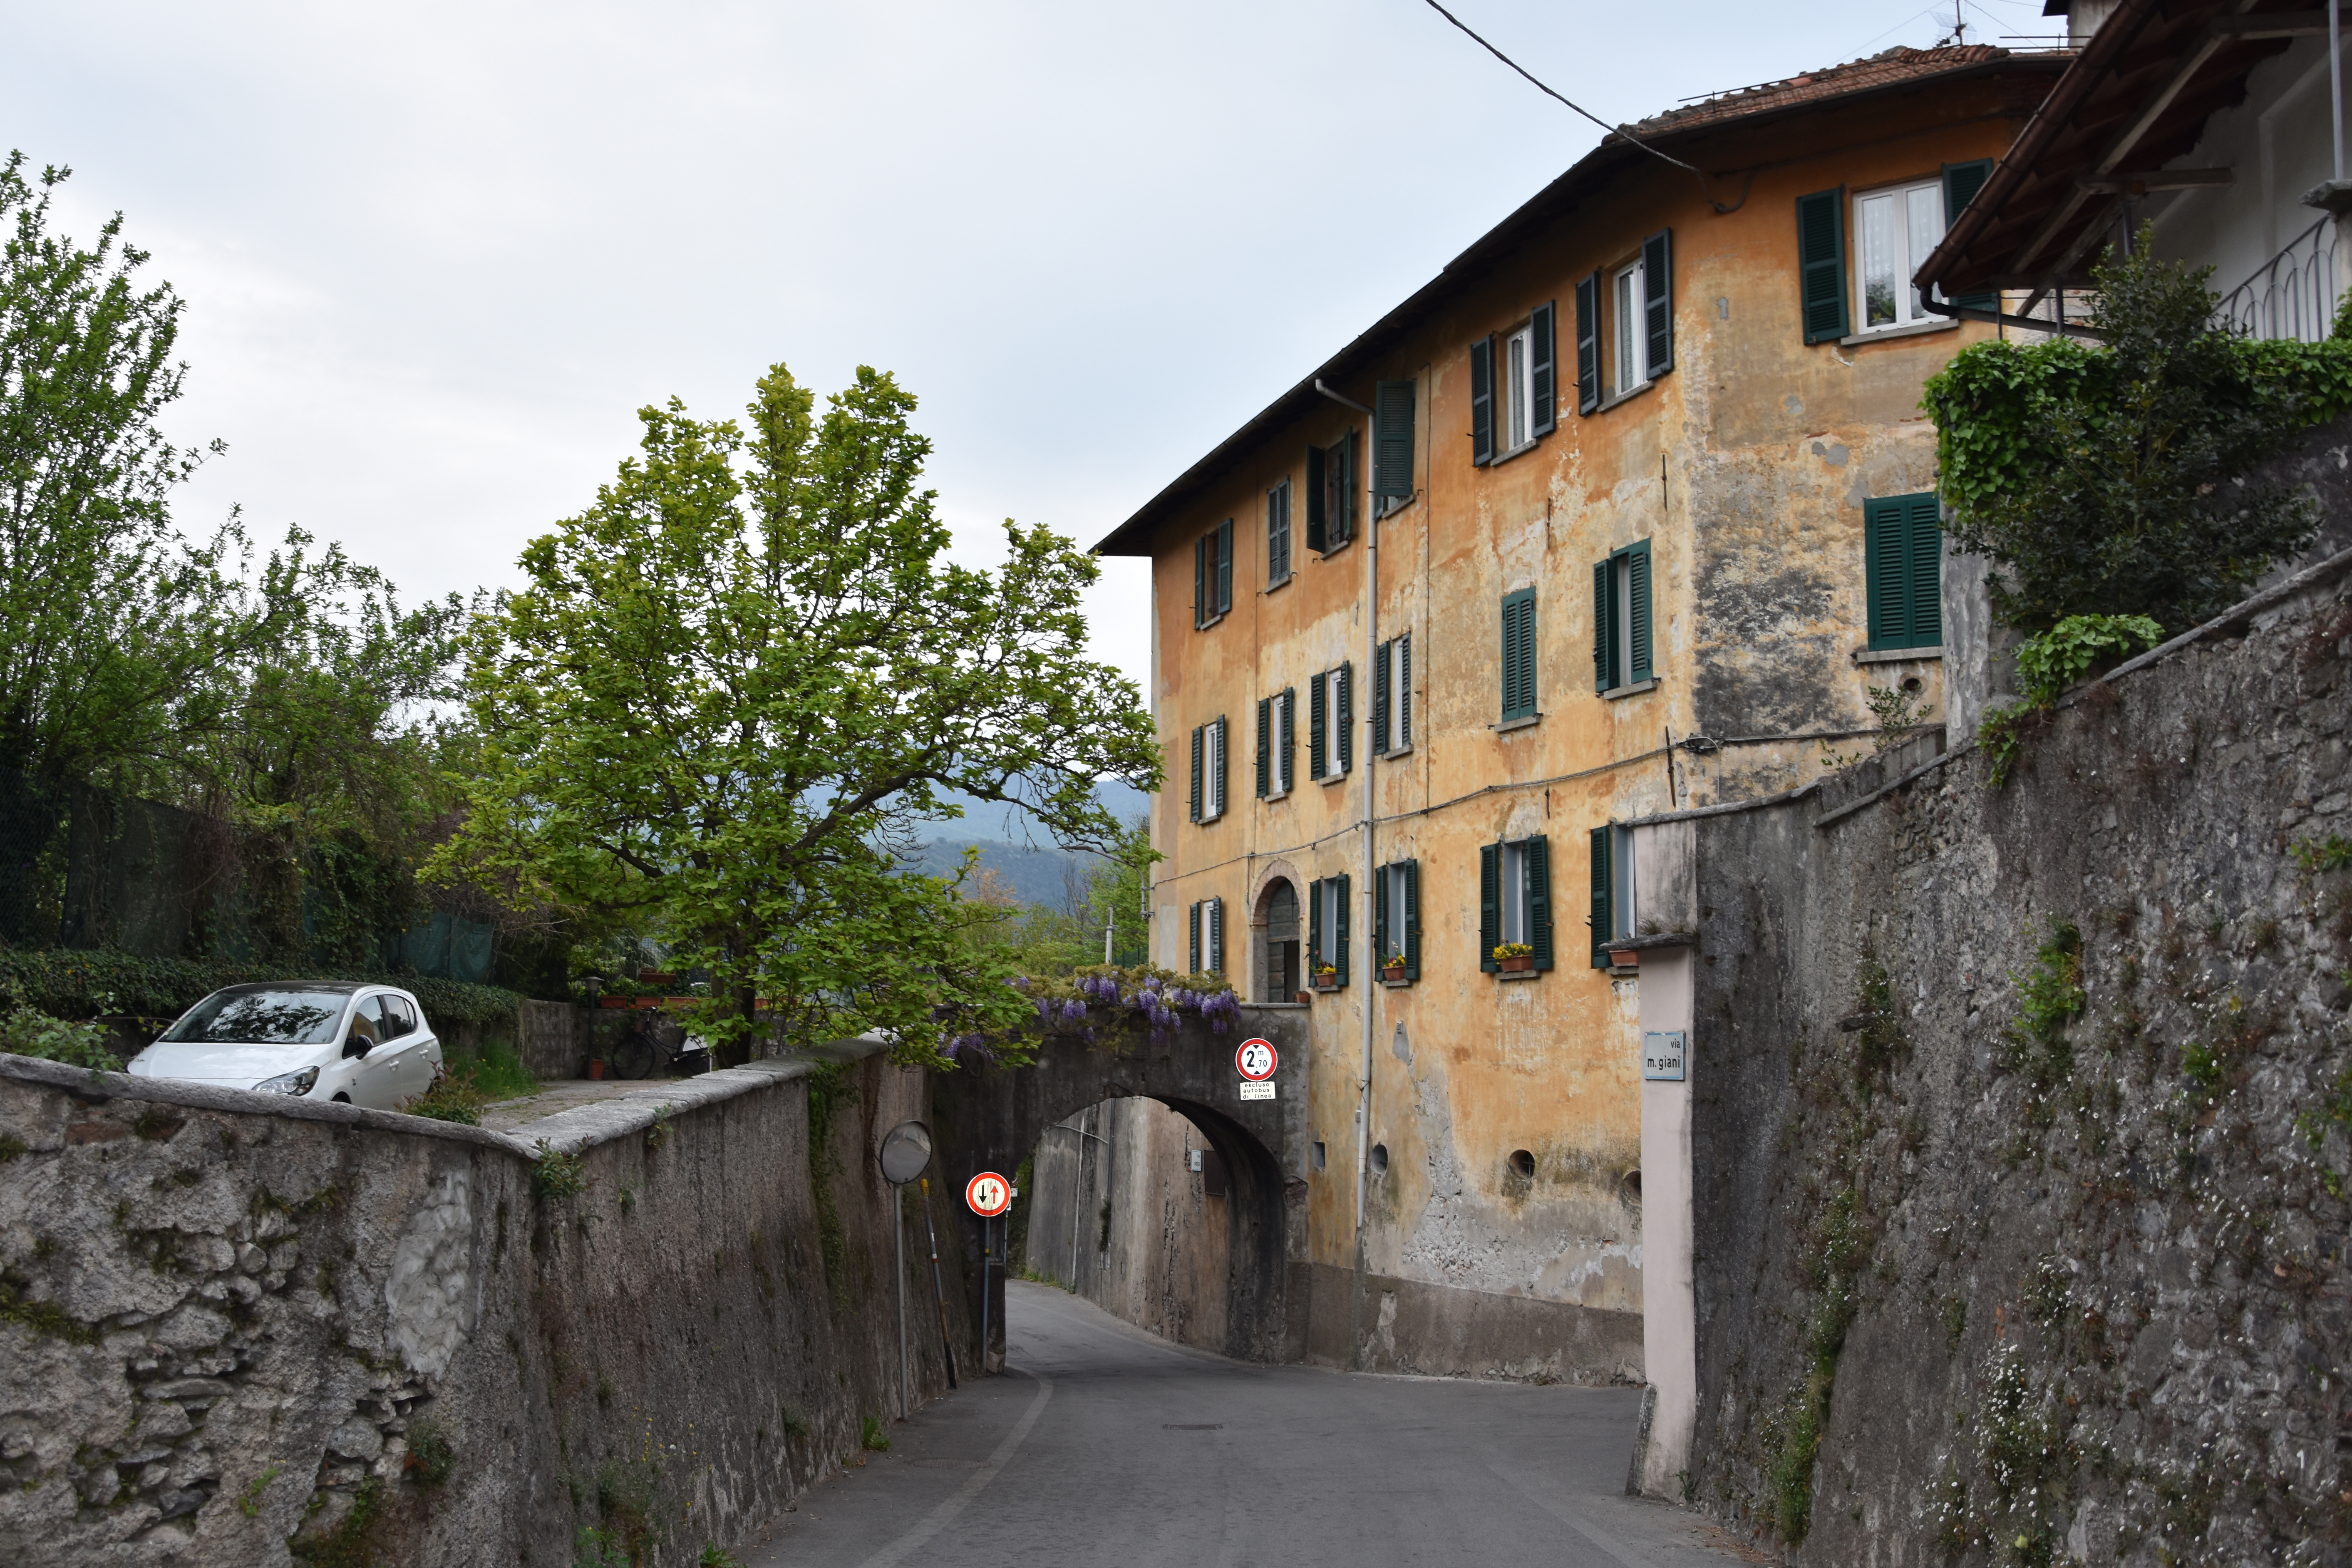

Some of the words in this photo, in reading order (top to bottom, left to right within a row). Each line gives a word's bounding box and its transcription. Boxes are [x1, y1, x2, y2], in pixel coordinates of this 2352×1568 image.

[1671, 1038, 1680, 1049] via
[1647, 1058, 1657, 1068] m.
[1659, 1055, 1680, 1071] giani
